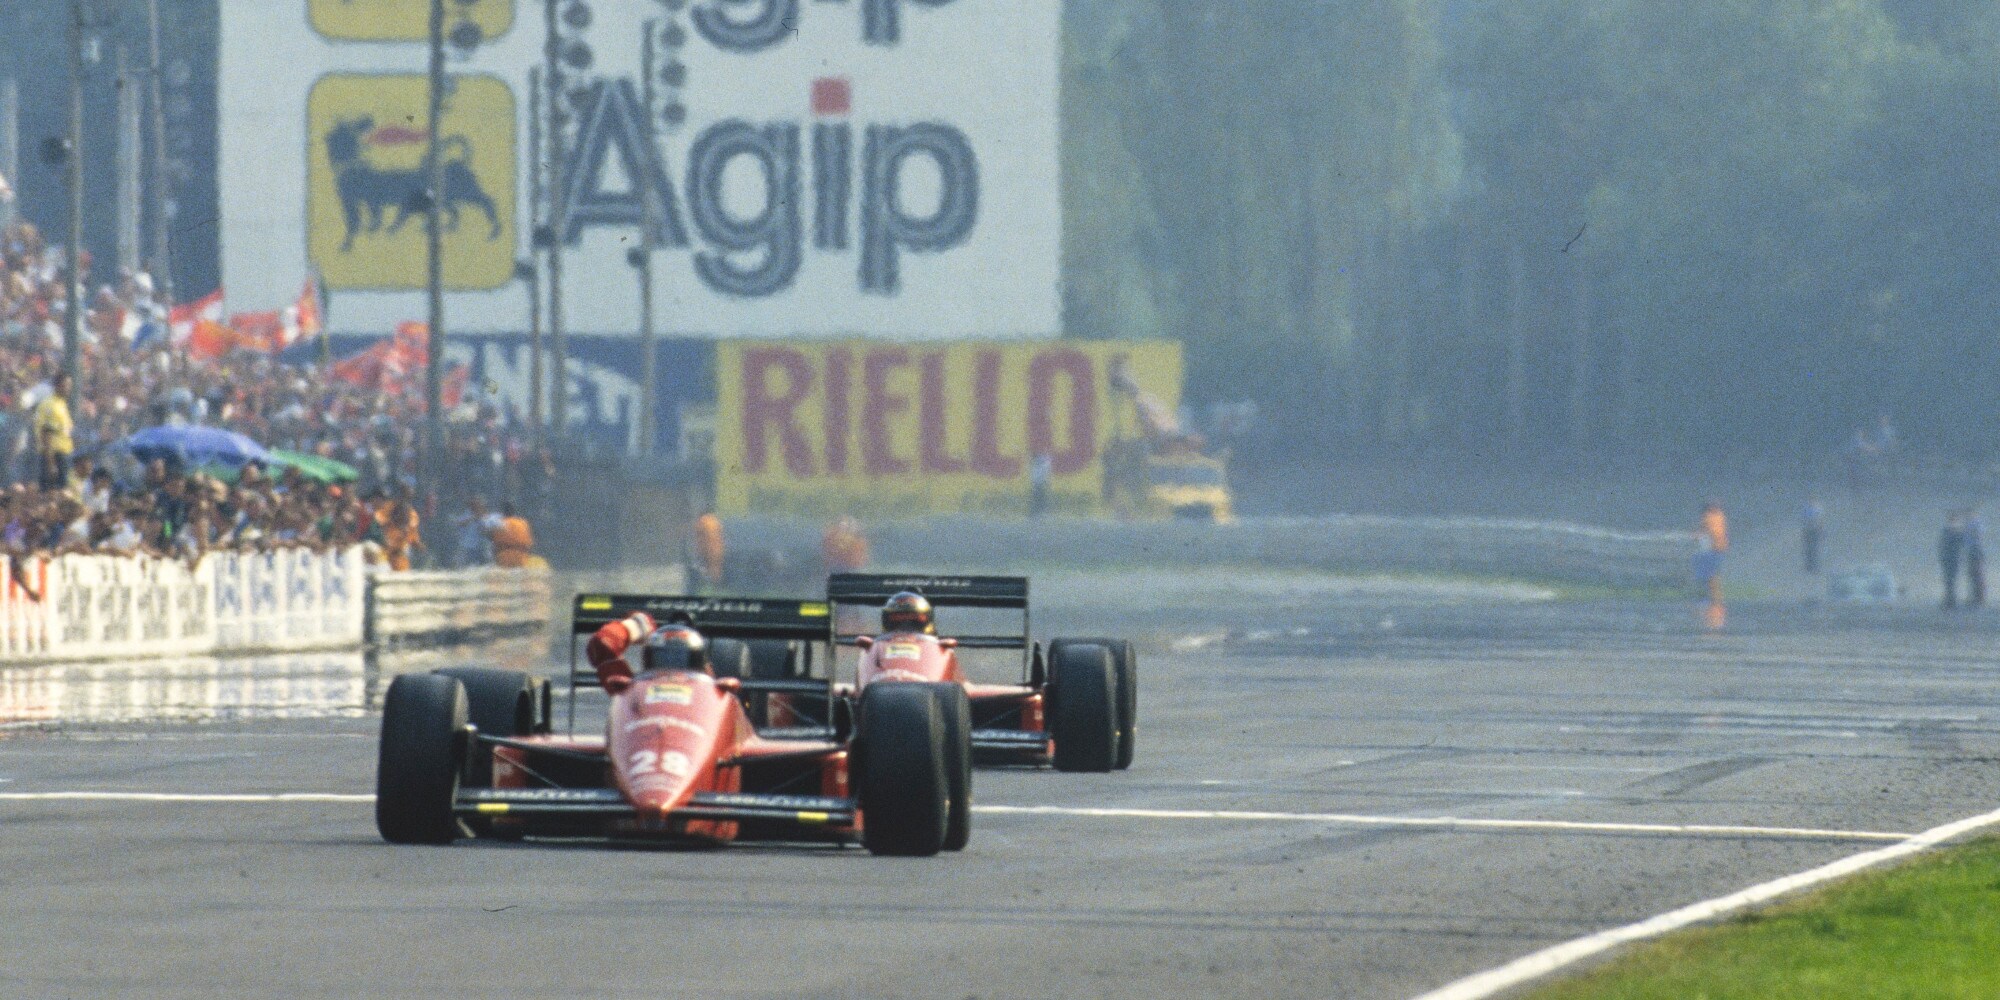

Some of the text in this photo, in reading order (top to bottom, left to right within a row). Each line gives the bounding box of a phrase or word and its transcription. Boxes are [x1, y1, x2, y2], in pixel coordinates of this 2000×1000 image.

[561, 77, 981, 296] Agip
[741, 347, 1098, 479] RIELLO
[628, 750, 689, 777] 28
